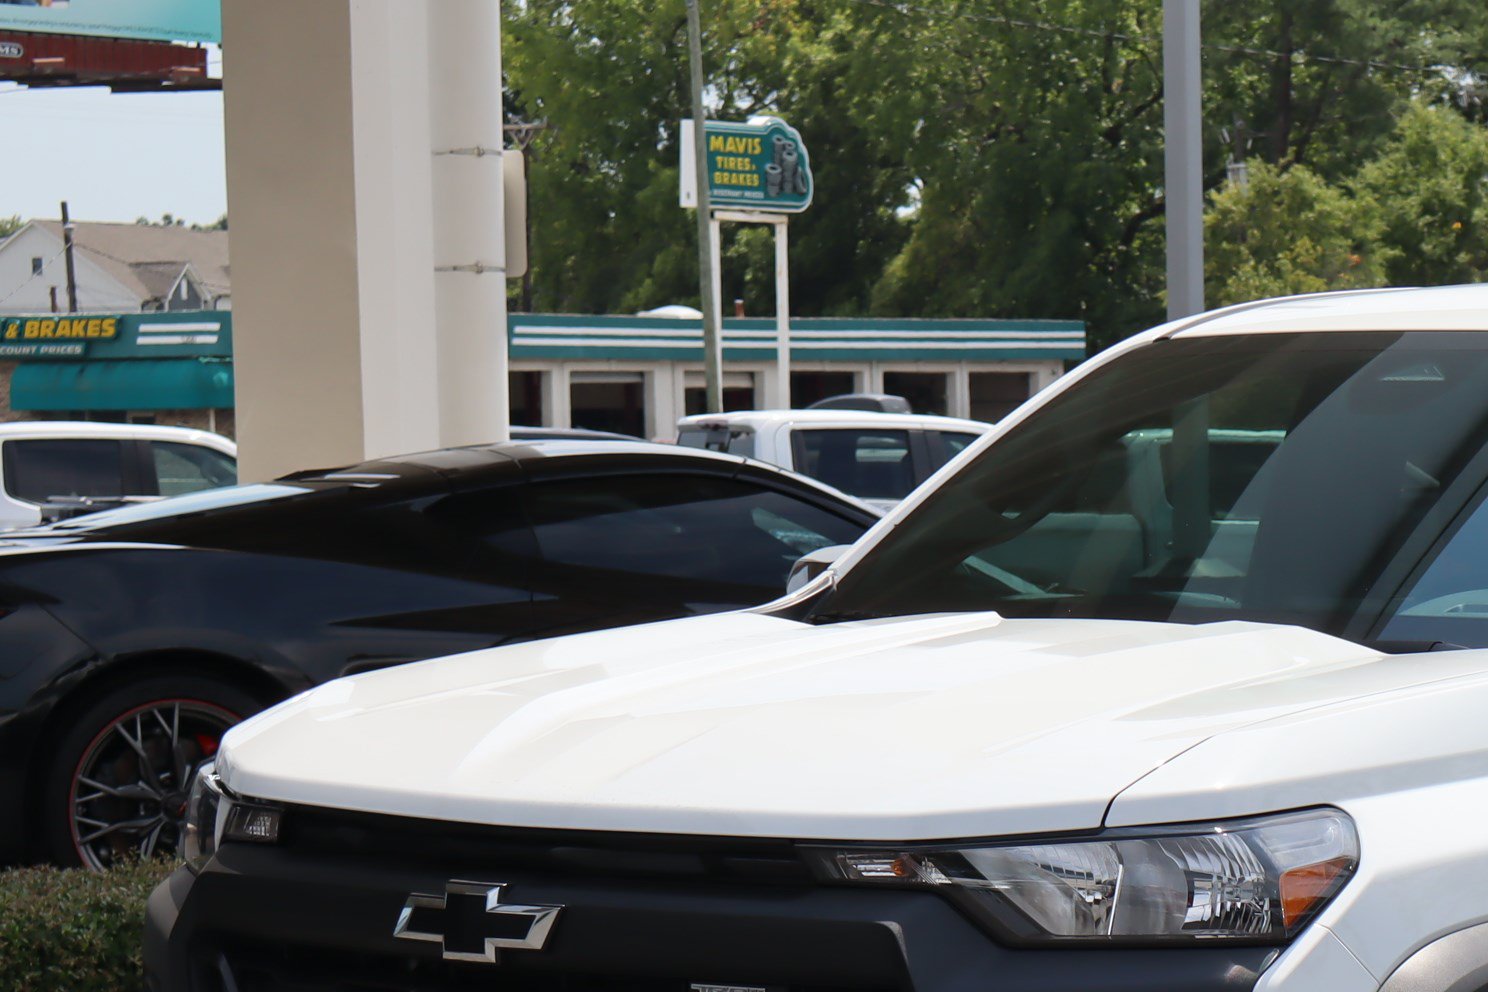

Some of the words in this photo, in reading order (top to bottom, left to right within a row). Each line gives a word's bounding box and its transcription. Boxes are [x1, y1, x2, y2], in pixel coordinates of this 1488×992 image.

[709, 135, 762, 155] MAVIS
[716, 156, 751, 171] TIRES
[713, 172, 759, 187] BRAKES
[4, 322, 18, 339] &
[24, 318, 117, 339] BRAKES
[40, 344, 82, 355] PRICES
